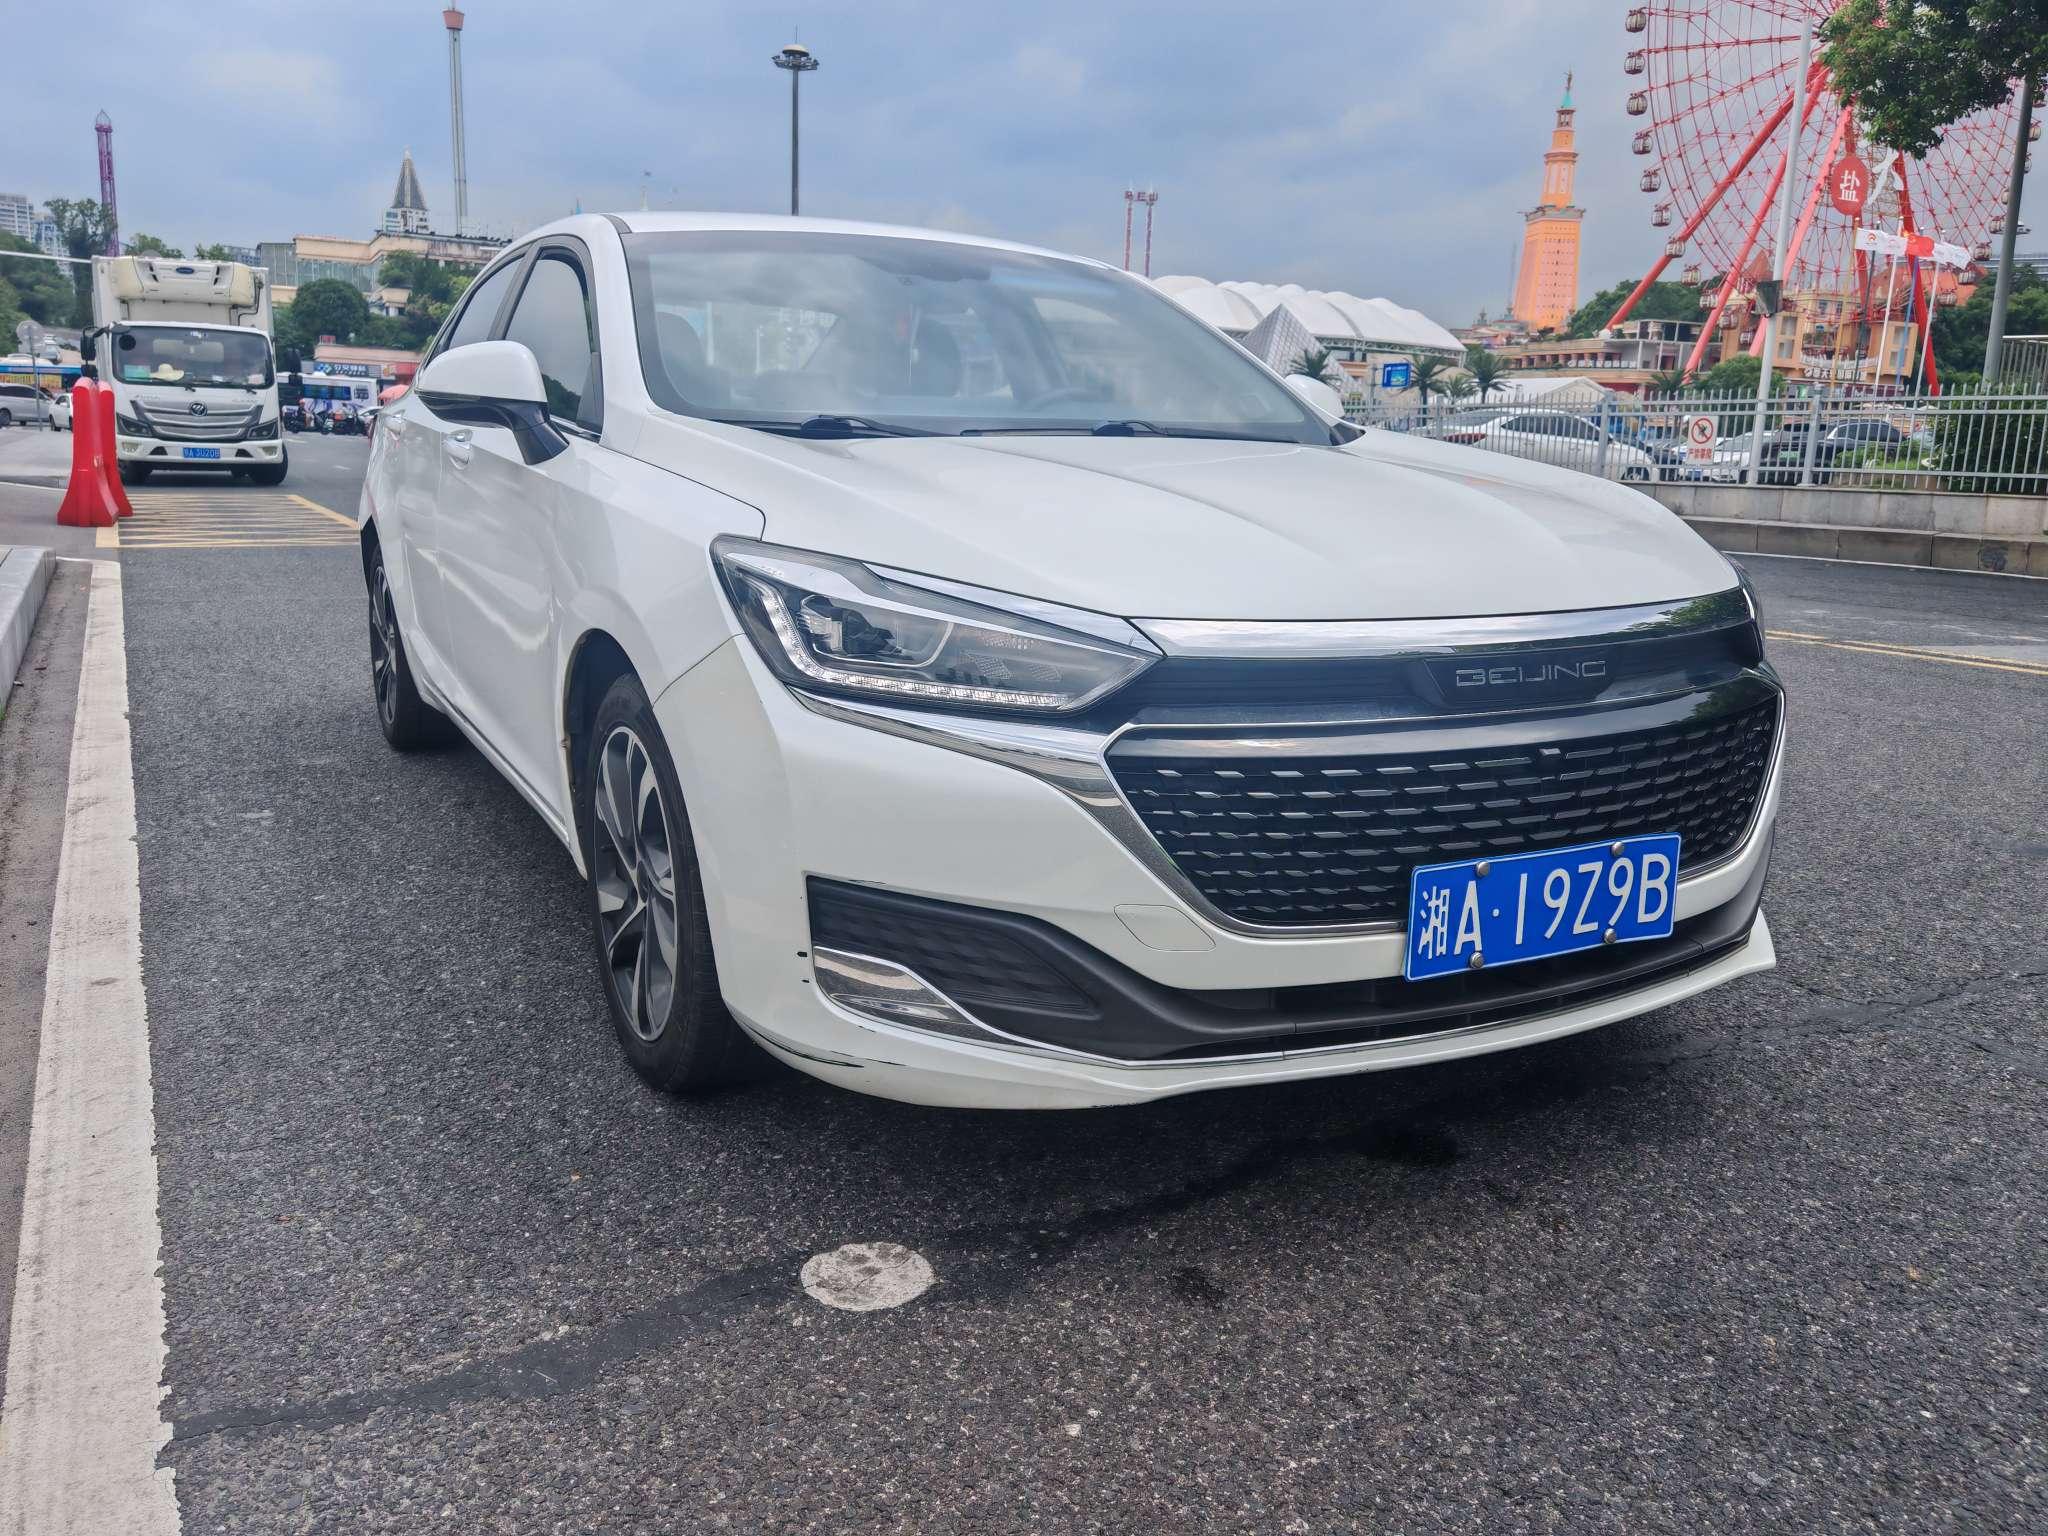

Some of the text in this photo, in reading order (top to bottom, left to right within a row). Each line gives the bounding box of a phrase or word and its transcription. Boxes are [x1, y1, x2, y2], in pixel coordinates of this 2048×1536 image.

[1837, 169, 1861, 203] 盐
[1455, 660, 1607, 688] BEIJING
[1418, 854, 1670, 959] 湘A·19Z9B
